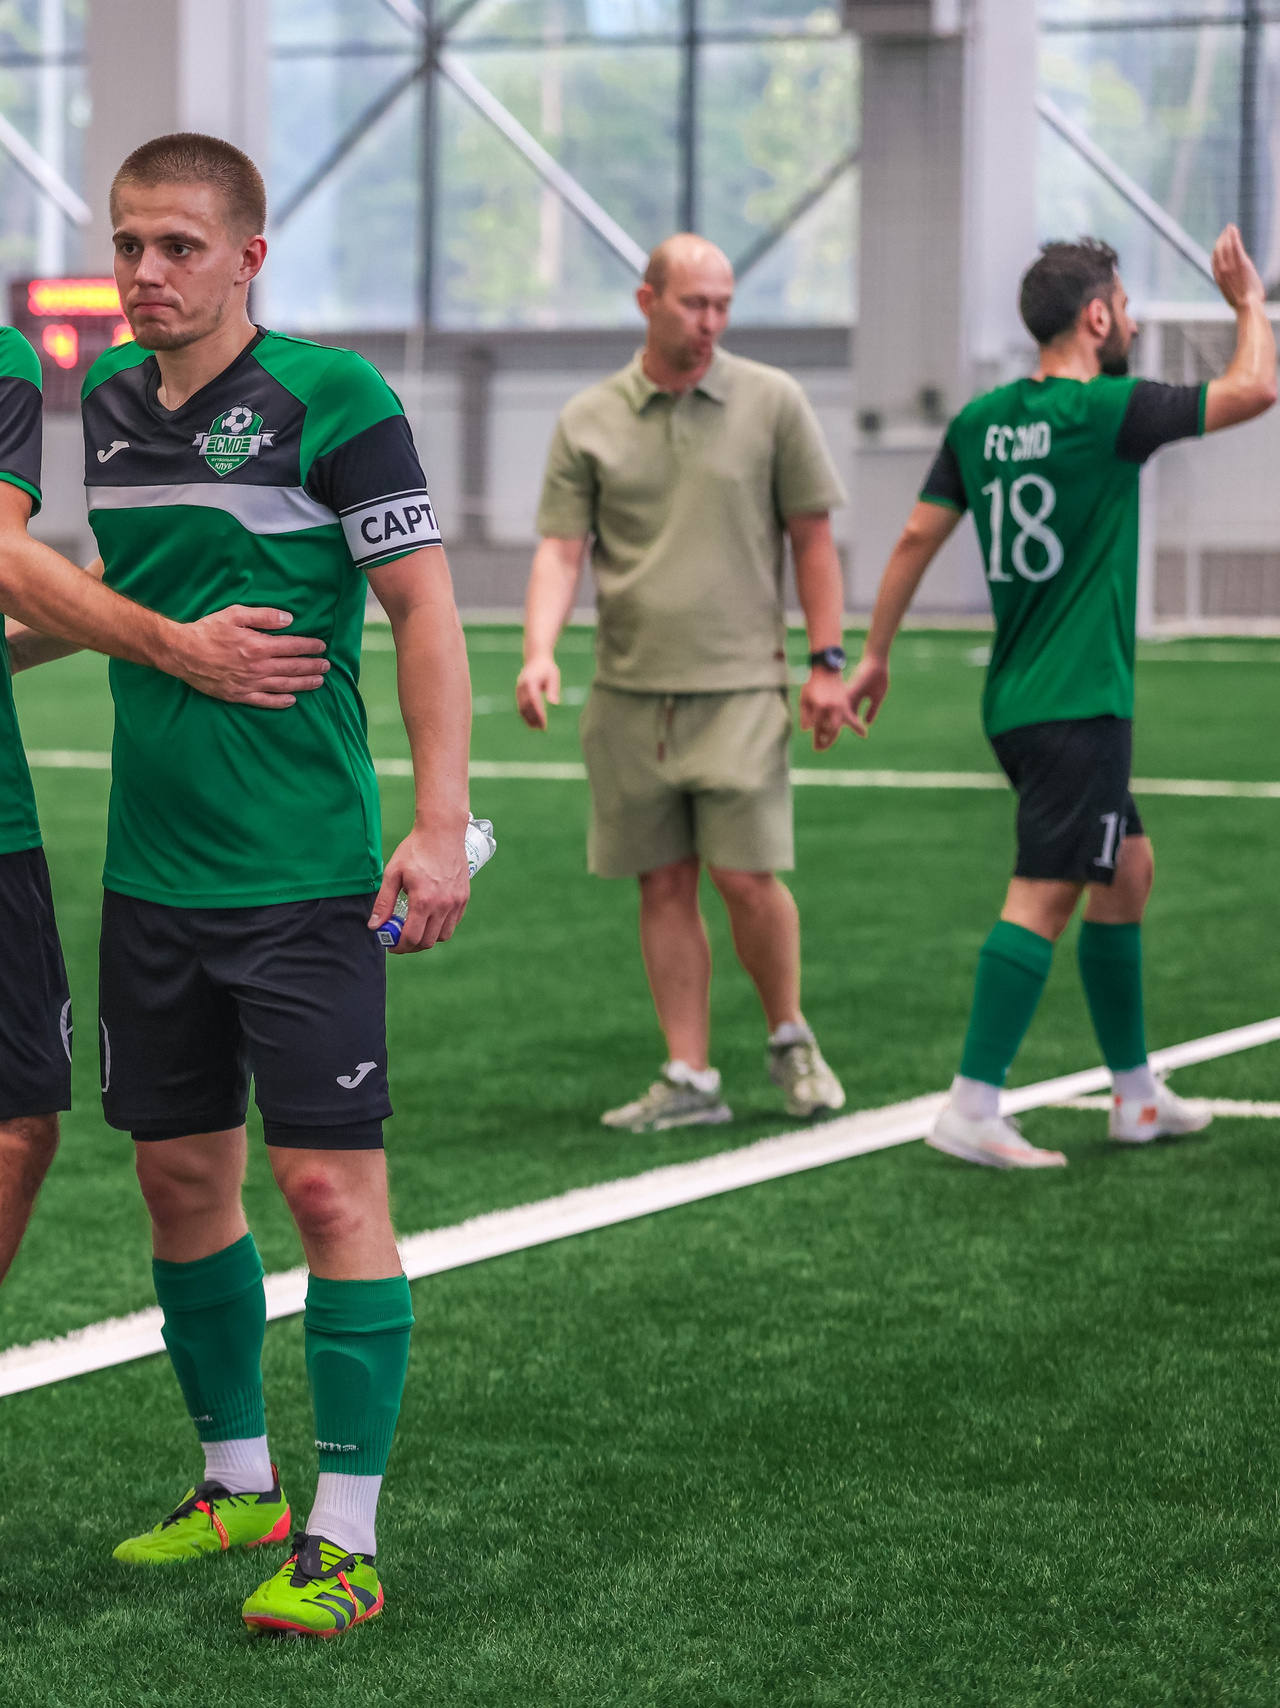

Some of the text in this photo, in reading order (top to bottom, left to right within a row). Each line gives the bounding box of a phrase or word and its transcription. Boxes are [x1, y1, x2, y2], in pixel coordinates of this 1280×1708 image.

[214, 436, 243, 453] CMD
[983, 424, 1014, 462] FC
[214, 462, 233, 471] КЛУБ
[360, 503, 440, 545] CAPT
[981, 473, 1065, 583] 18
[1092, 811, 1129, 869] 1
